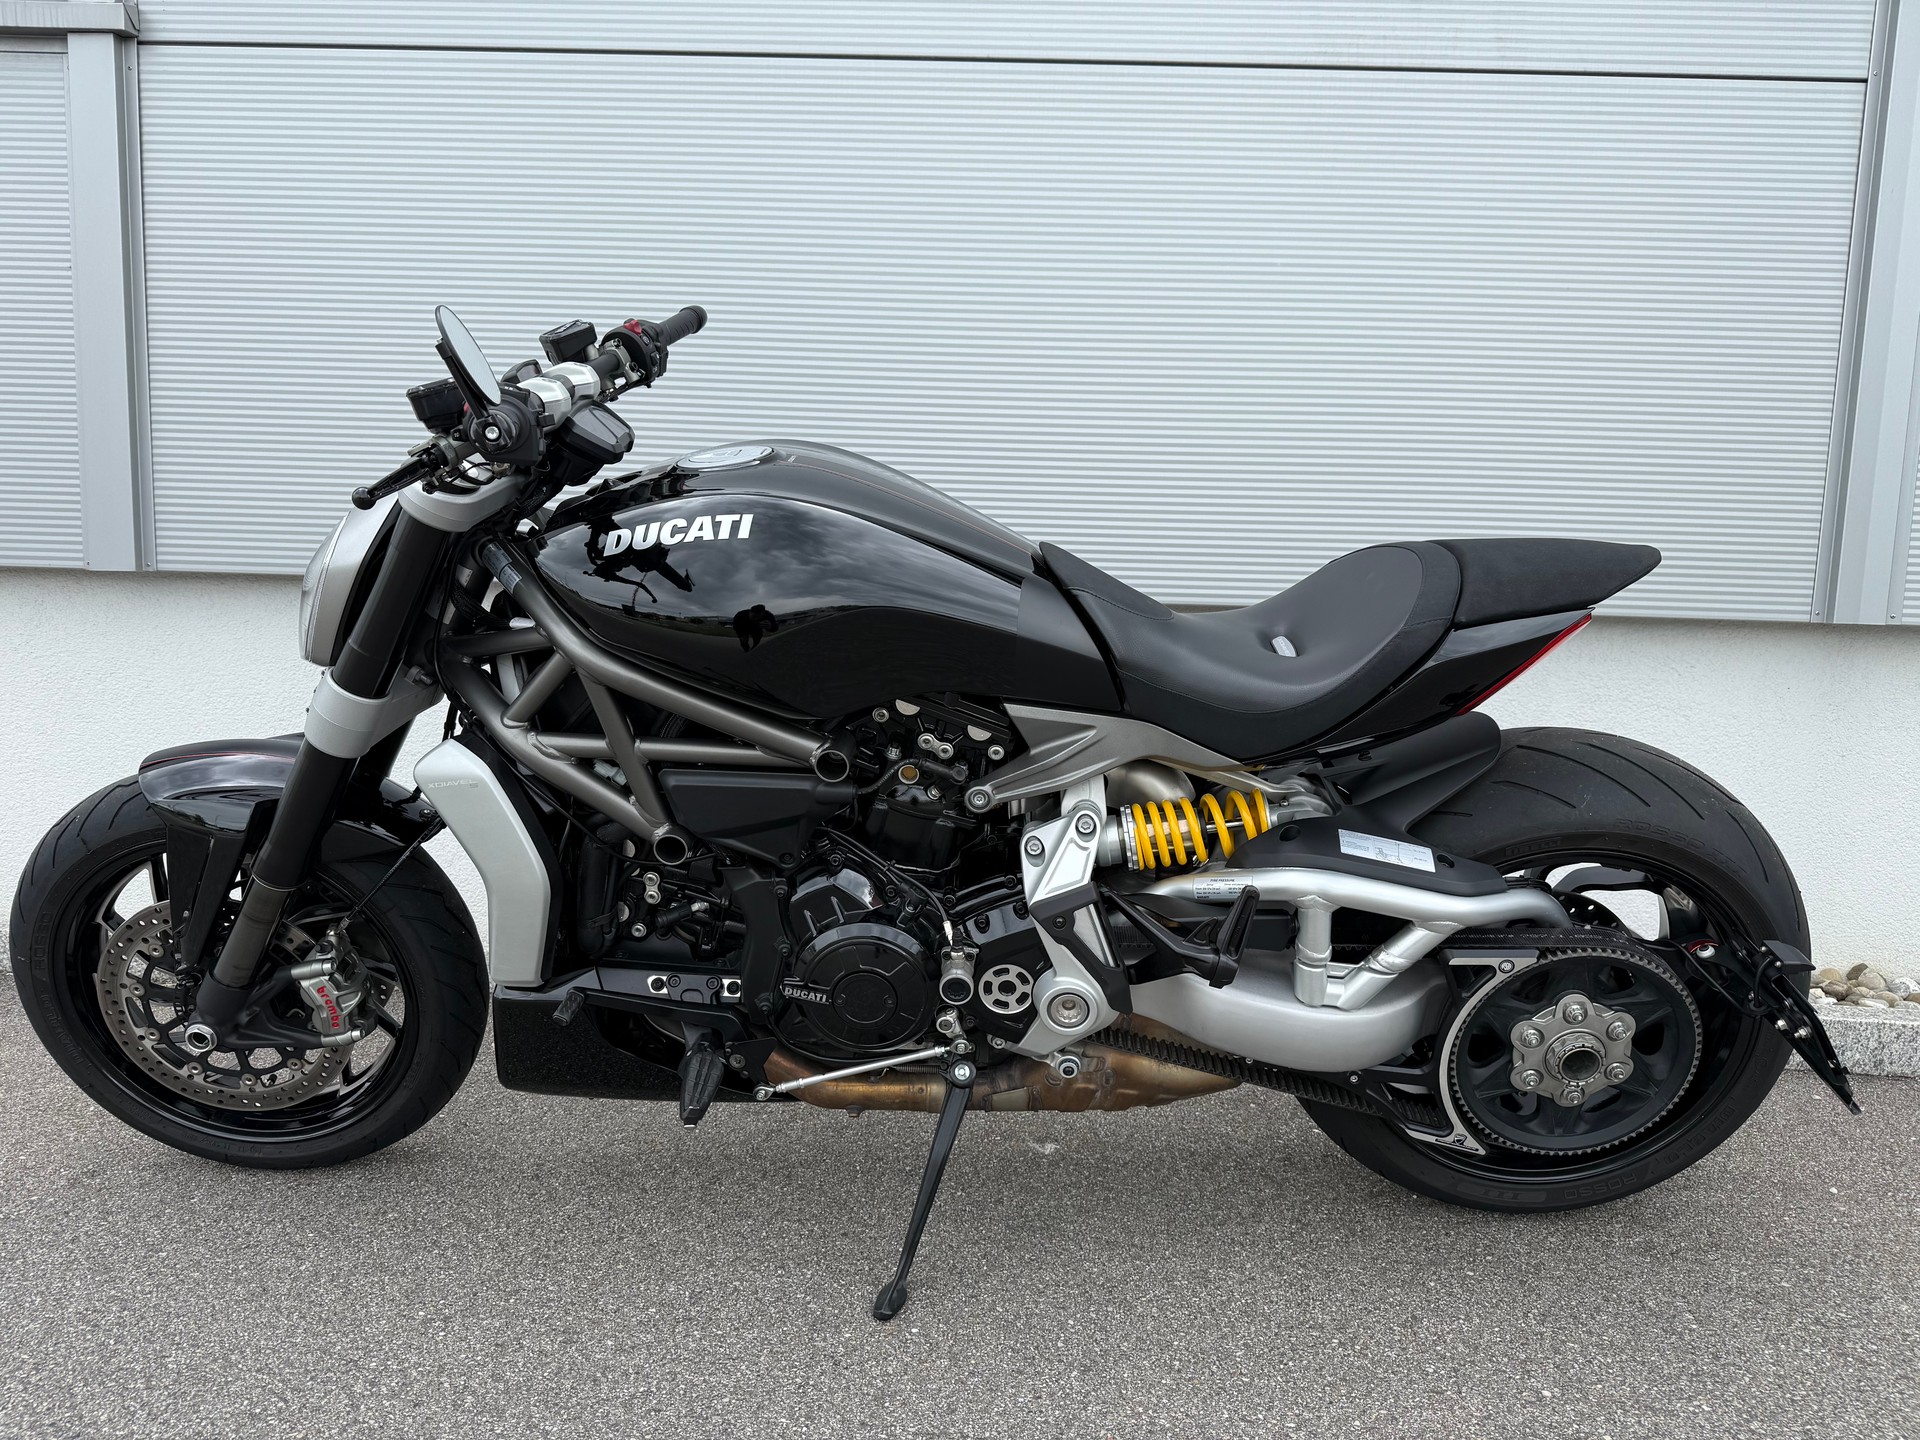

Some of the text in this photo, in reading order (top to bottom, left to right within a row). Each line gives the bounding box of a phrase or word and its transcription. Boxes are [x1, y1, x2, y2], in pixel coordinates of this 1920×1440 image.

[603, 513, 754, 557] DUCATI
[427, 779, 479, 789] XDIAVEL
[316, 986, 340, 1029] brembo
[784, 986, 827, 1002] DUCATI
[1564, 1172, 1637, 1199] ROSSO
